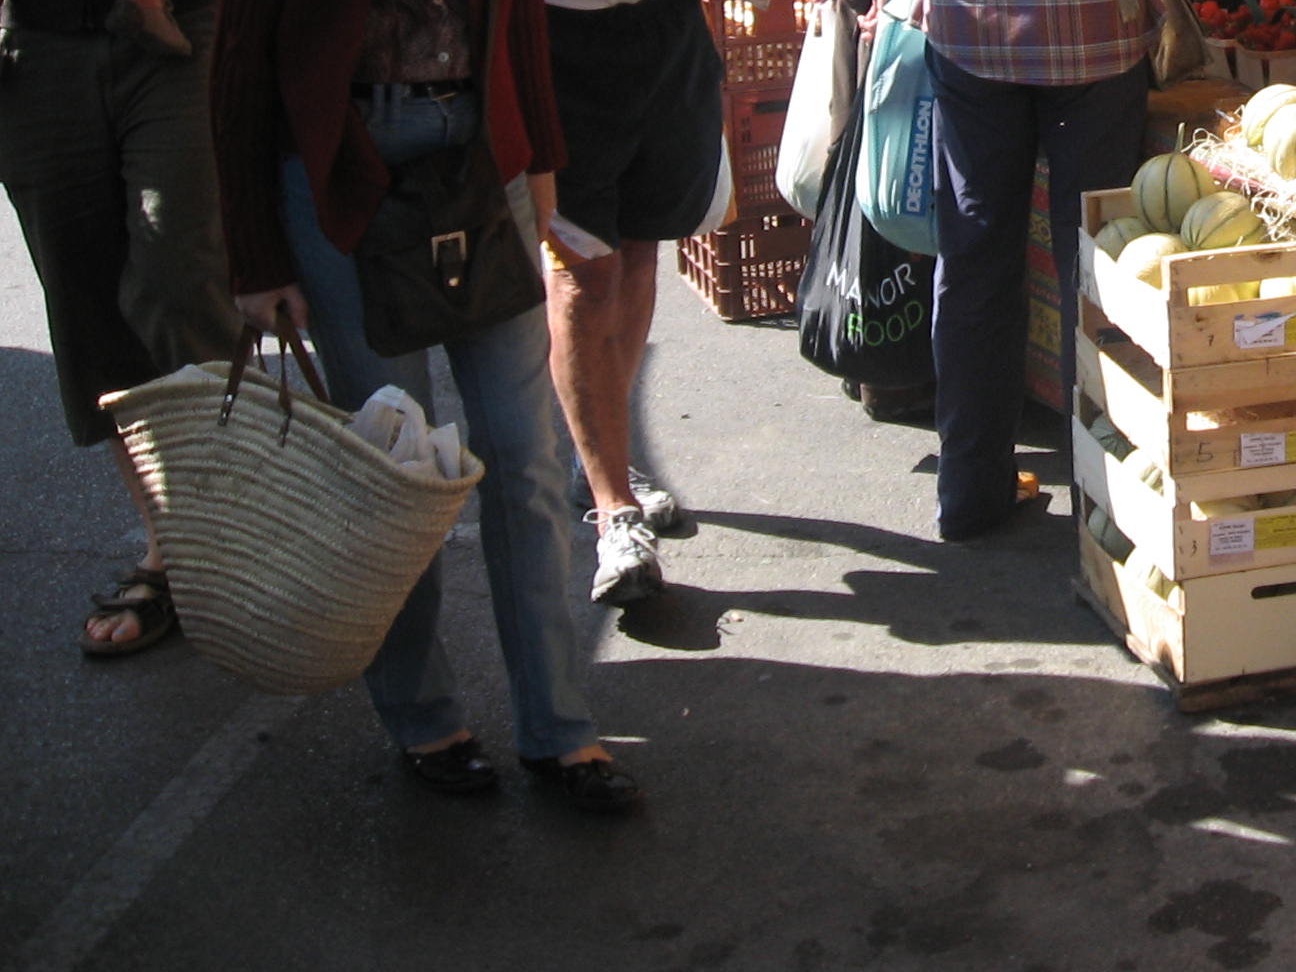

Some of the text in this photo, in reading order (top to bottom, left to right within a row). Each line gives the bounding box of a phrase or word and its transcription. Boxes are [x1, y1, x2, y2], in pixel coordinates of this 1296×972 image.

[906, 101, 932, 213] DECATHLON
[826, 261, 916, 309] MANOR
[848, 300, 924, 346] FOOD
[1195, 441, 1215, 464] 5
